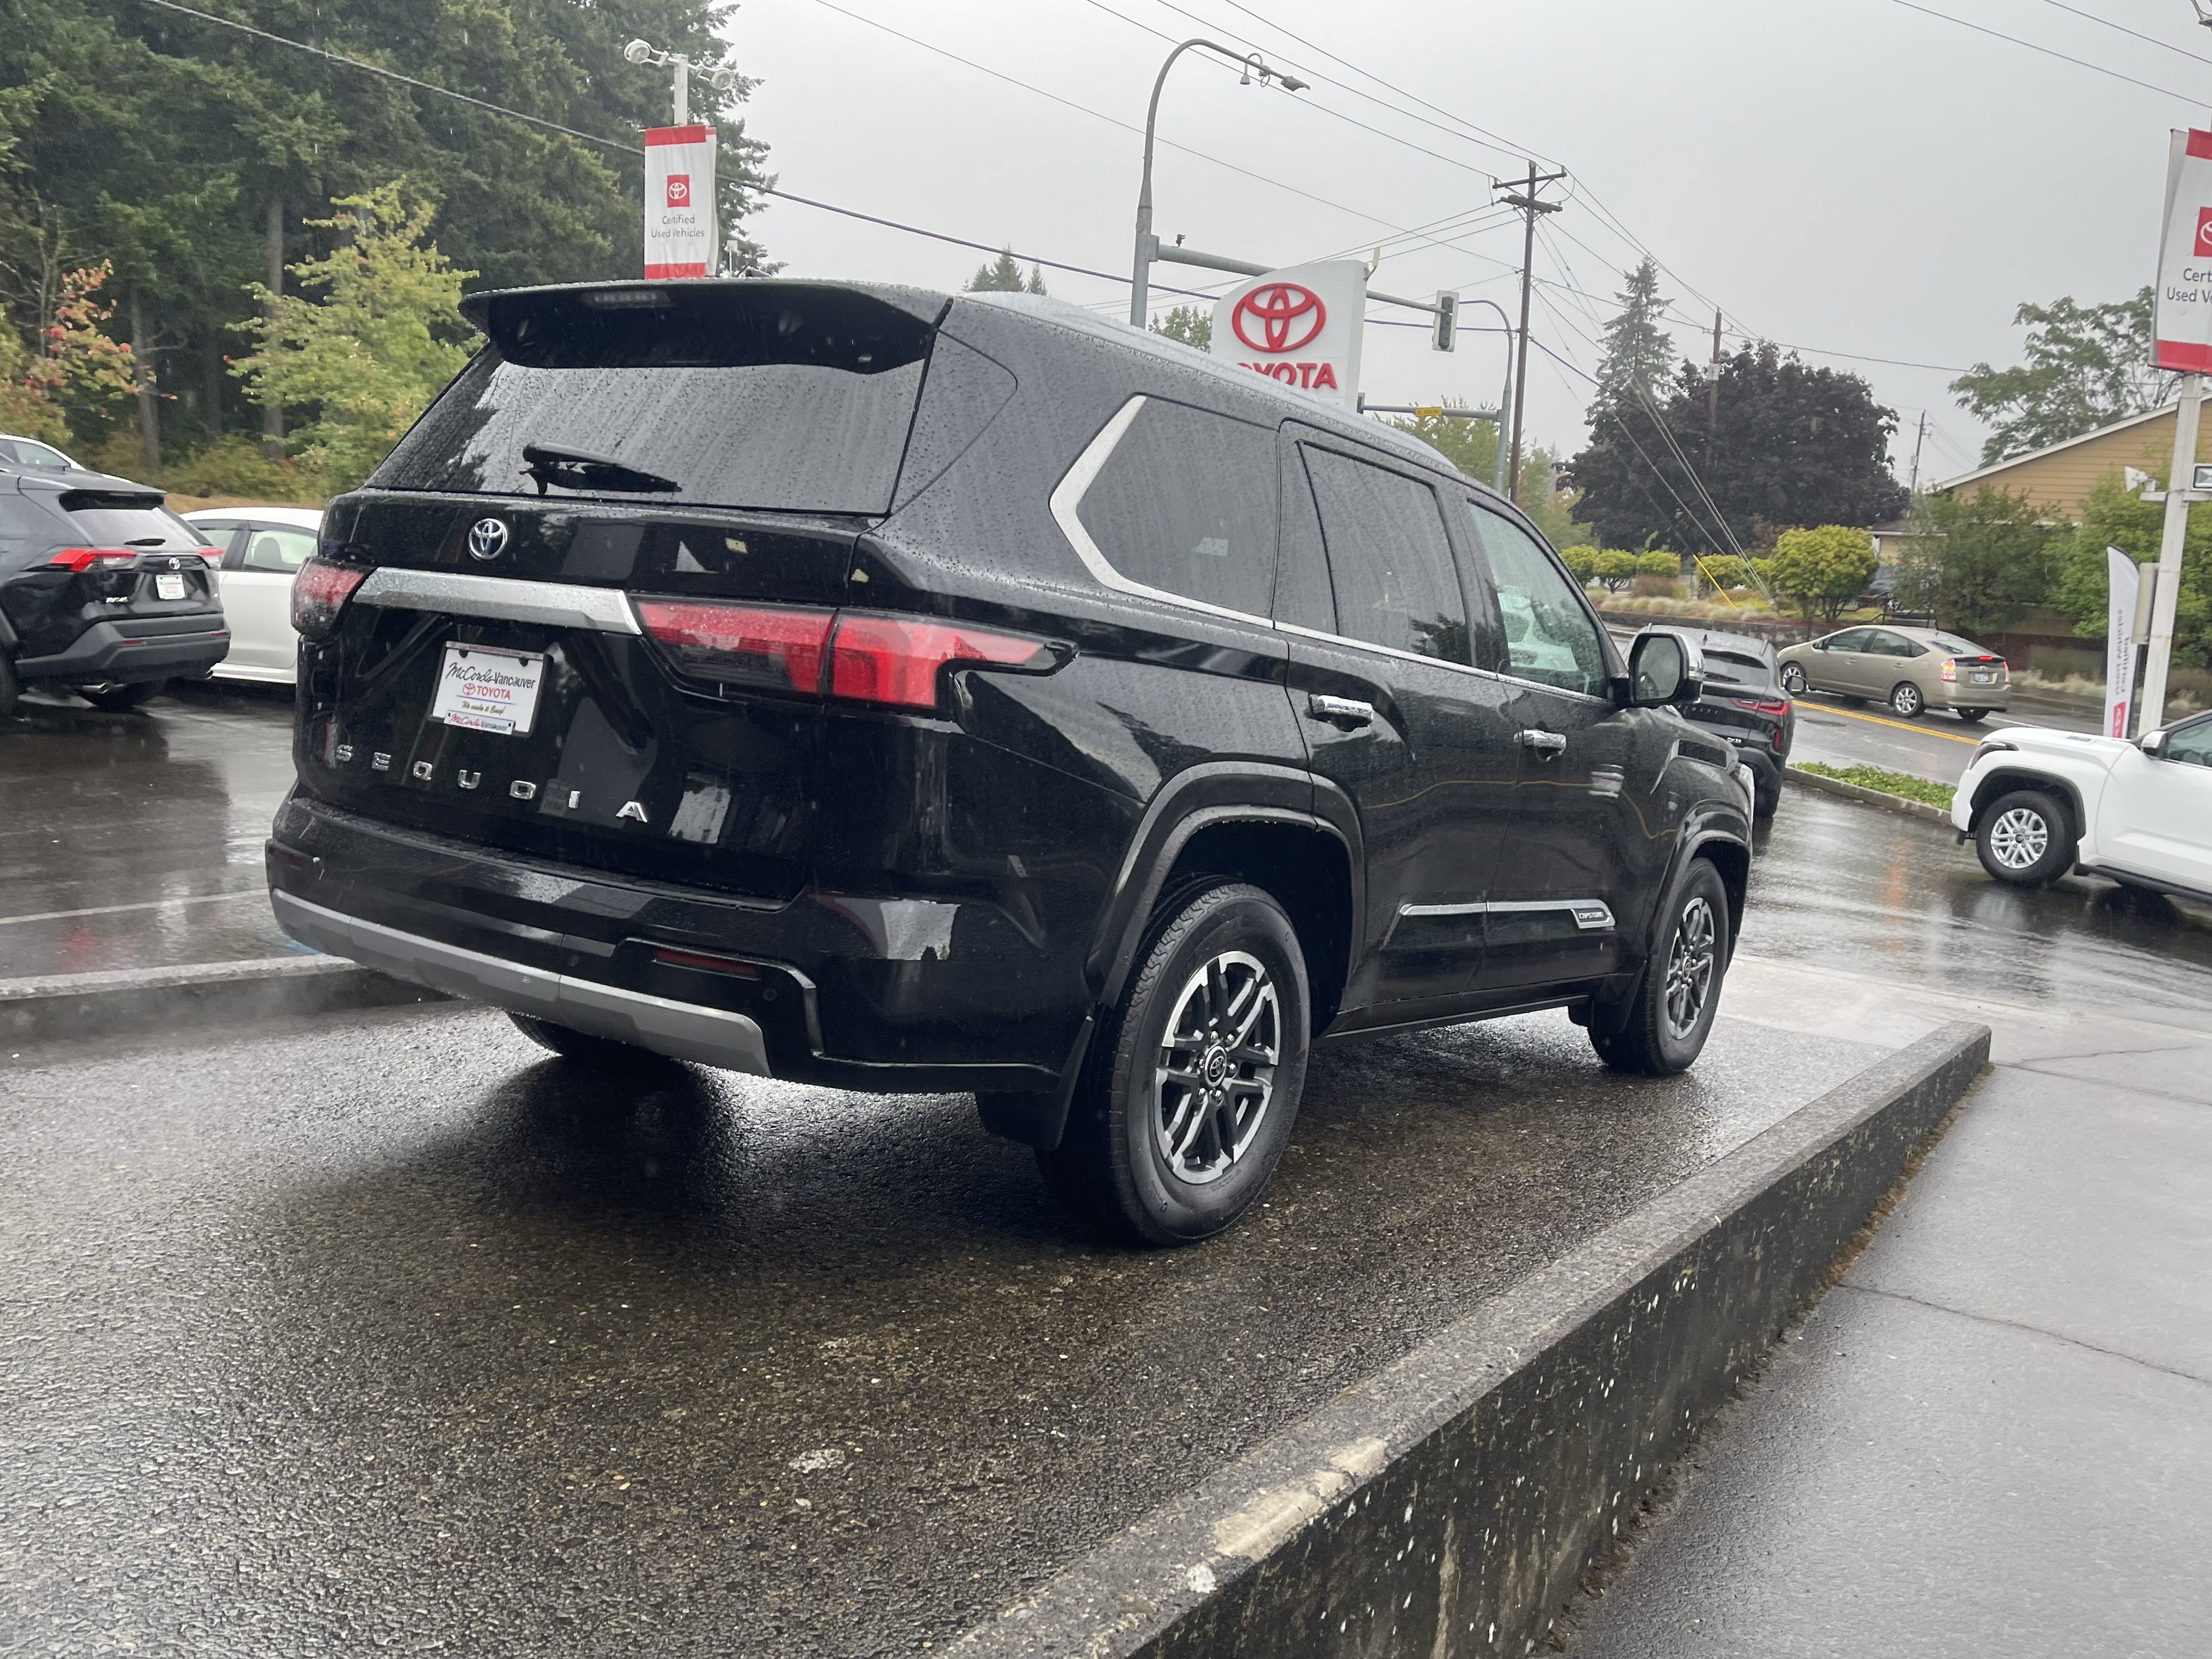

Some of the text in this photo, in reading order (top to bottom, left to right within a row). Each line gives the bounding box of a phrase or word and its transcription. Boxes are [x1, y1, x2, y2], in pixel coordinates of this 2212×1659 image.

[662, 215, 695, 224] Certified
[651, 228, 704, 238] Used Vehicles
[2167, 286, 2197, 302] Used
[494, 672, 536, 689] Vancouver
[477, 685, 511, 700] TOYOTA
[336, 744, 648, 823] SEQUOIA
